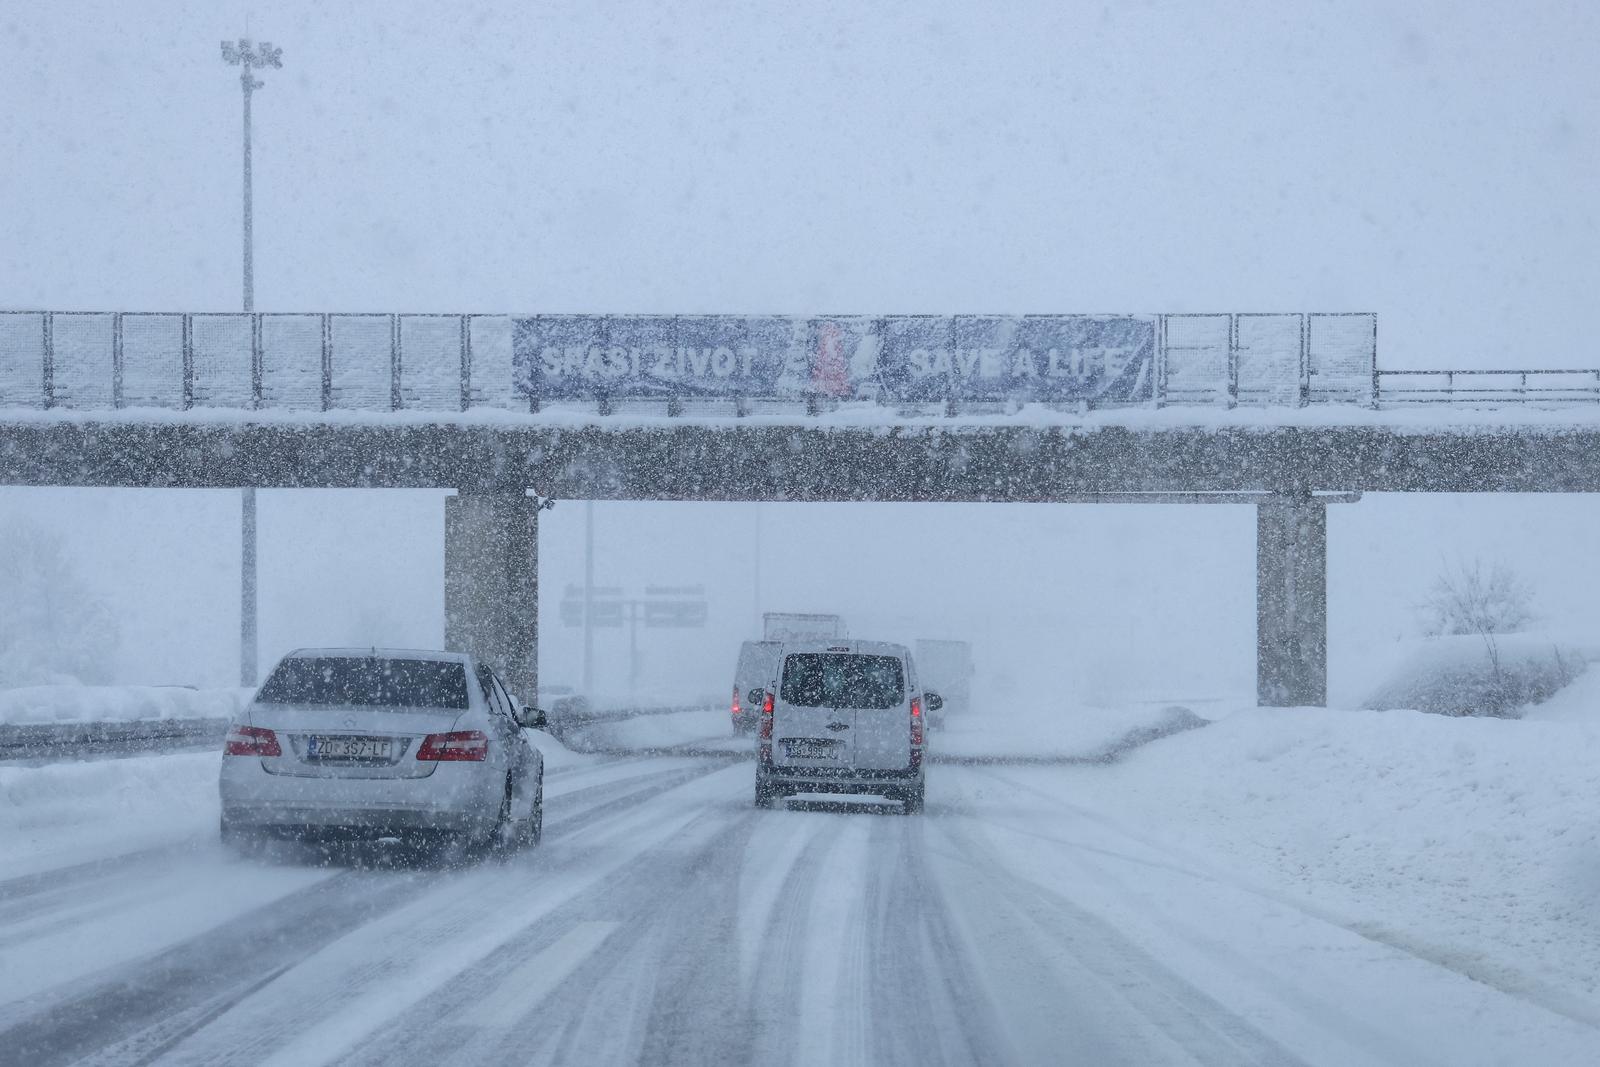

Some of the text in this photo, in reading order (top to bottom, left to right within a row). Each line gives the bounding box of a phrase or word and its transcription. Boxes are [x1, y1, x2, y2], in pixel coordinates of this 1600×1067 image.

[907, 346, 1129, 377] SAVE A LIFE
